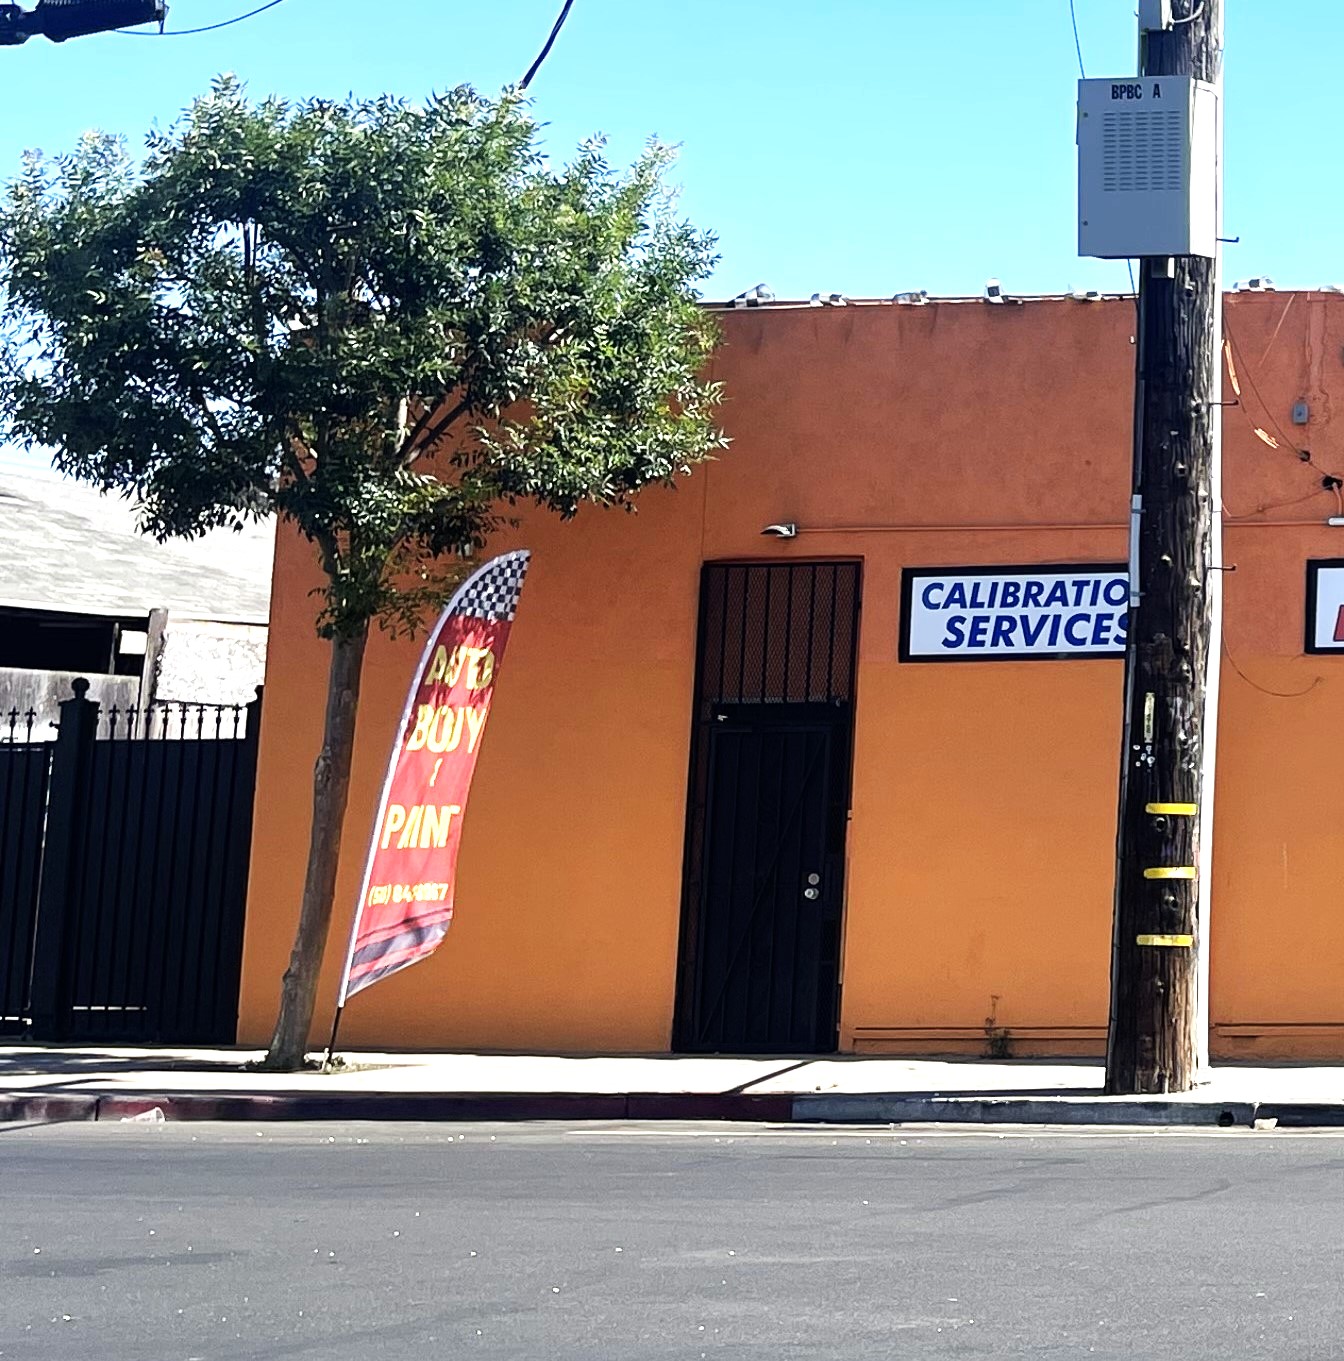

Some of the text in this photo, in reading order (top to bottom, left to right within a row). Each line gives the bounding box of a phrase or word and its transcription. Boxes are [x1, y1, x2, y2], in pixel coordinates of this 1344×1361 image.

[1111, 83, 1161, 100] BPBC A
[921, 578, 1130, 610] CALIBRATIO
[941, 611, 1130, 650] SERVICES
[425, 644, 495, 690] AUTO
